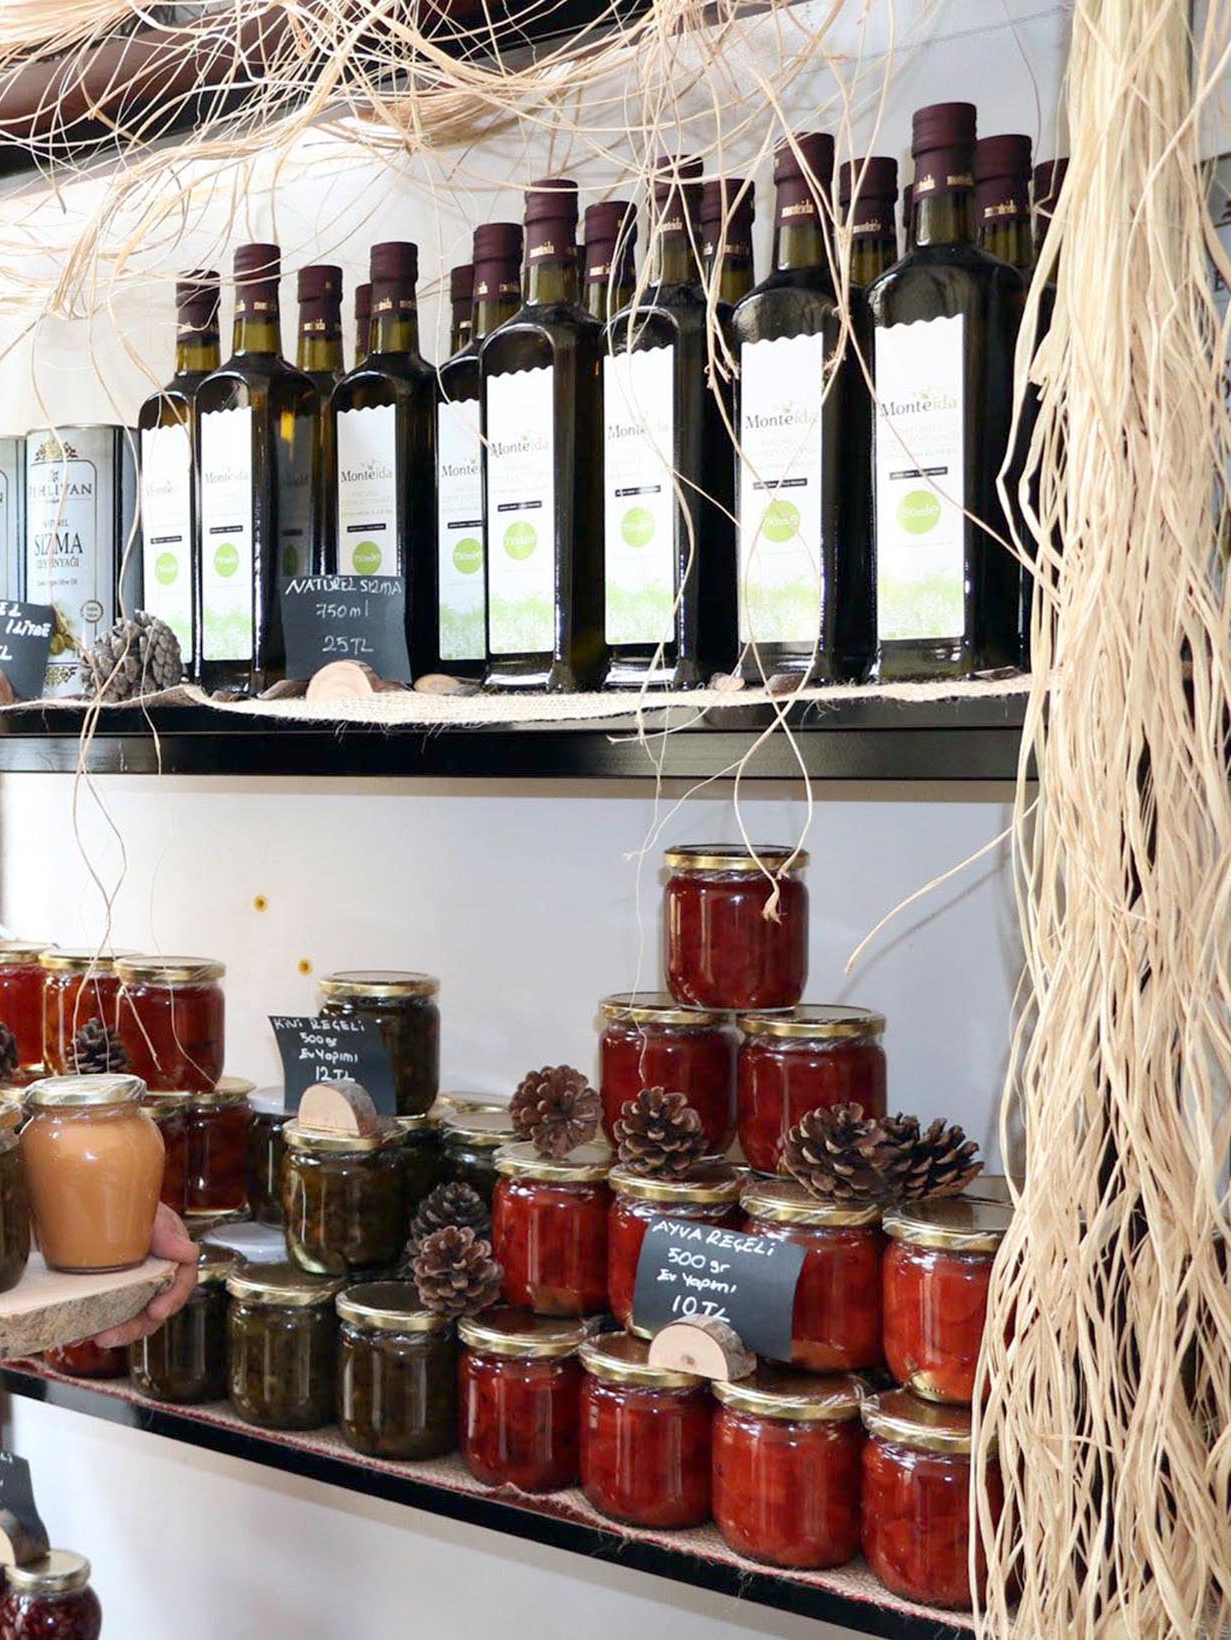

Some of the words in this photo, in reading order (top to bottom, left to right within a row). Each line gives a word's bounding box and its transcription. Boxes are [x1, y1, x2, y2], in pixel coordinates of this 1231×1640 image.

[608, 421, 668, 439] Monteda
[441, 463, 479, 478] Monte
[652, 1220, 701, 1241] AYVA
[668, 1248, 705, 1268] 500
